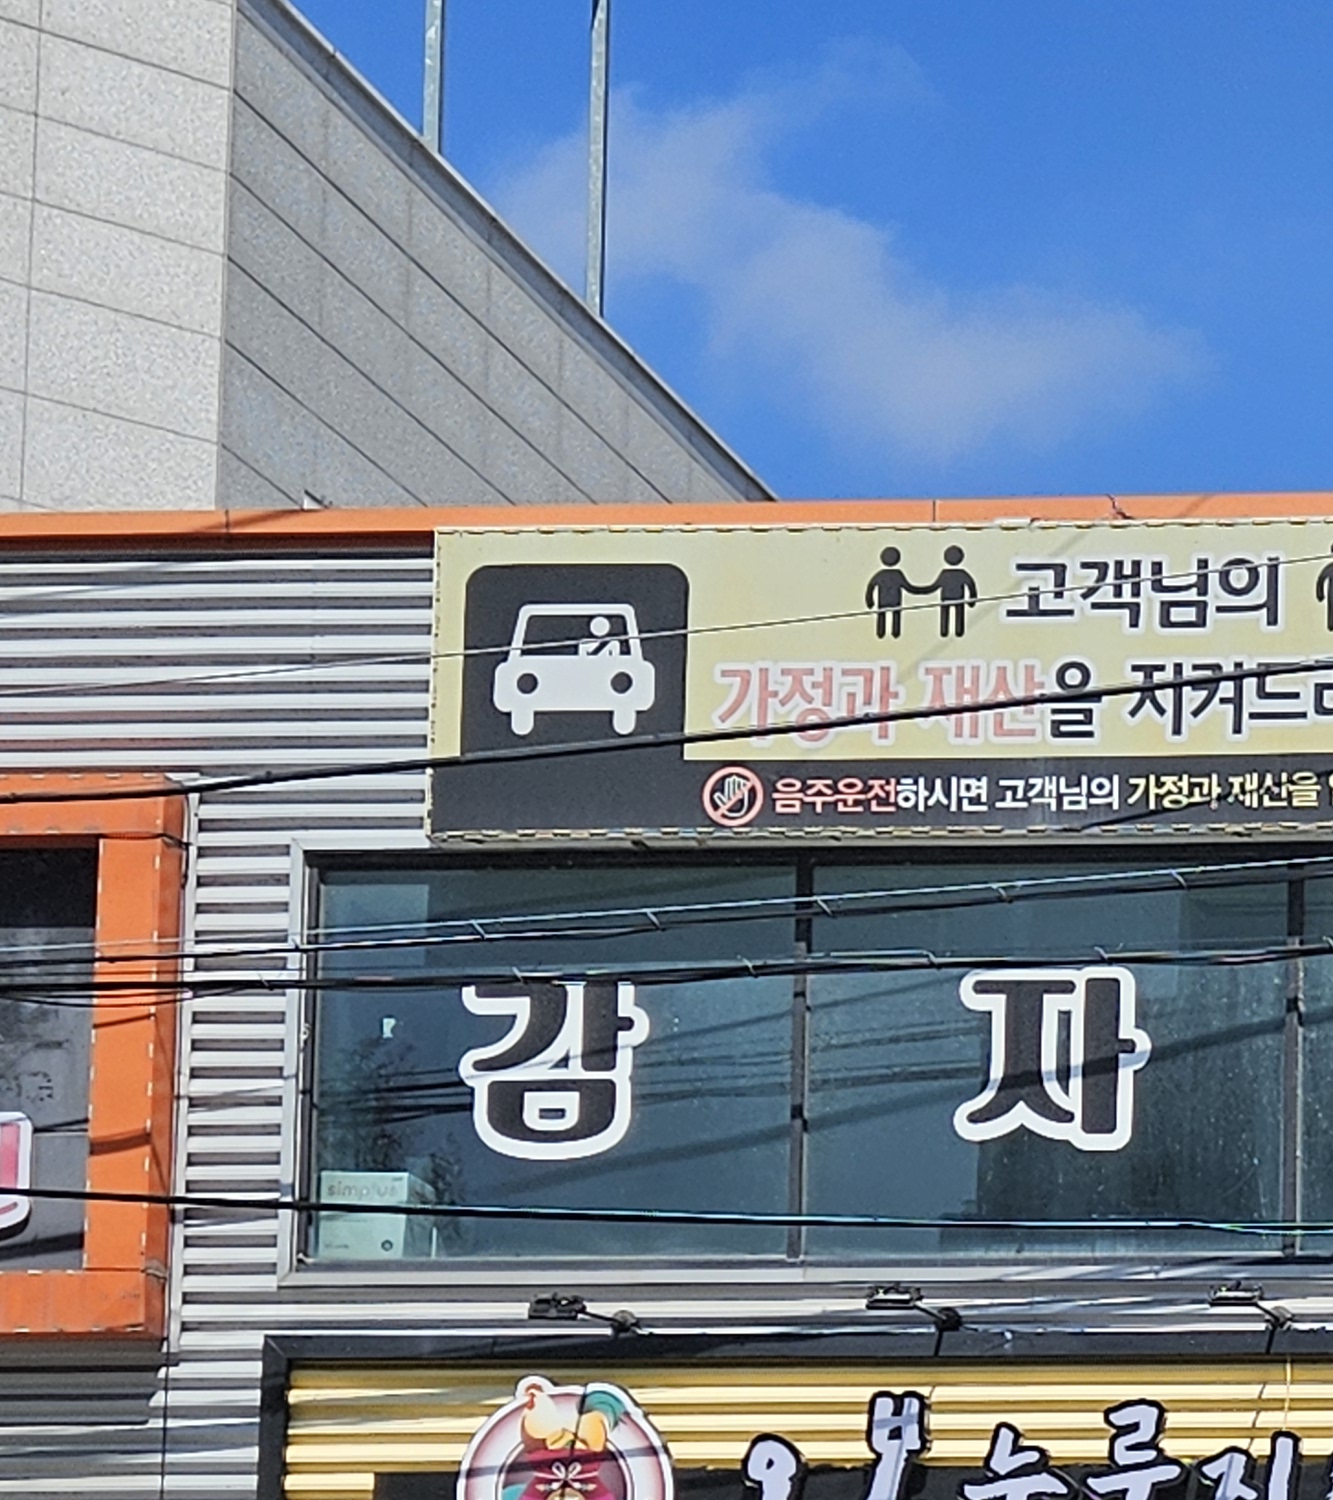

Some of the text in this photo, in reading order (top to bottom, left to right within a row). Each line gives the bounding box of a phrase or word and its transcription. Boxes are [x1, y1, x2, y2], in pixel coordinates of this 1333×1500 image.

[1005, 556, 1281, 629] 고객님의
[718, 663, 902, 743] 가정과
[923, 659, 1103, 741] 재산을
[771, 775, 989, 814] 음주운전하시면
[994, 774, 1121, 813] 고객님의
[1126, 772, 1222, 810] 가정과
[1228, 770, 1321, 808] 재산을
